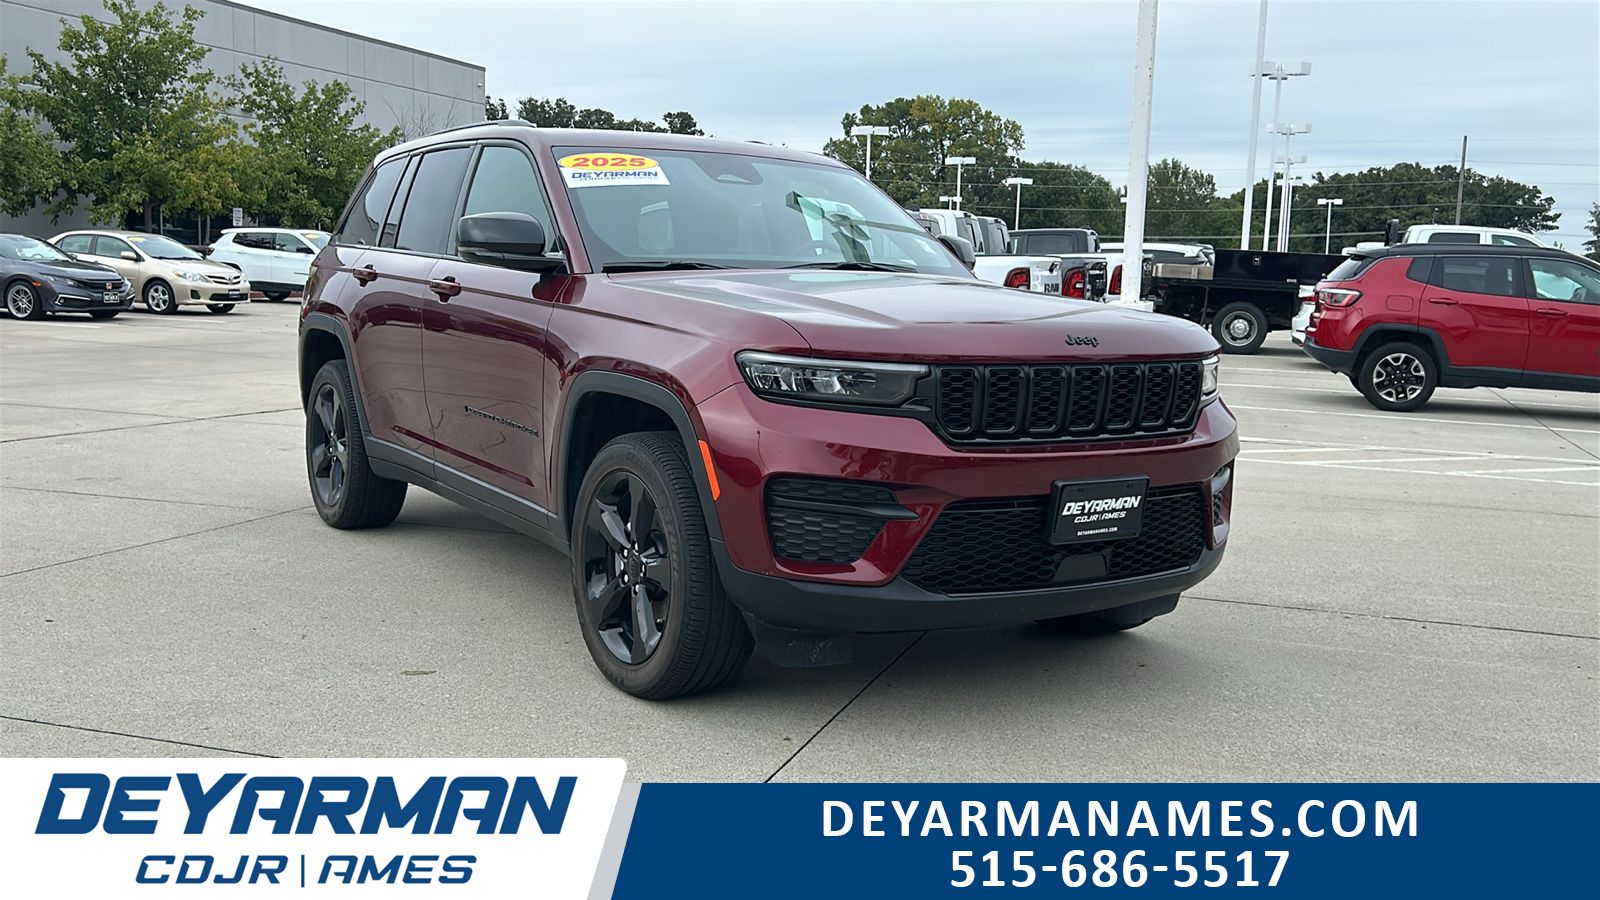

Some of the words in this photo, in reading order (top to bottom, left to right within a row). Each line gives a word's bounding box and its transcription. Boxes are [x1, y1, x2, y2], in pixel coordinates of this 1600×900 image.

[572, 157, 646, 167] 2025
[571, 171, 658, 179] DEYARMAN
[1044, 283, 1060, 293] RAM
[1065, 334, 1099, 348] Jeep
[1062, 496, 1141, 515] DEYARMAN
[1074, 514, 1099, 523] CDJR
[1101, 511, 1126, 520] AMES
